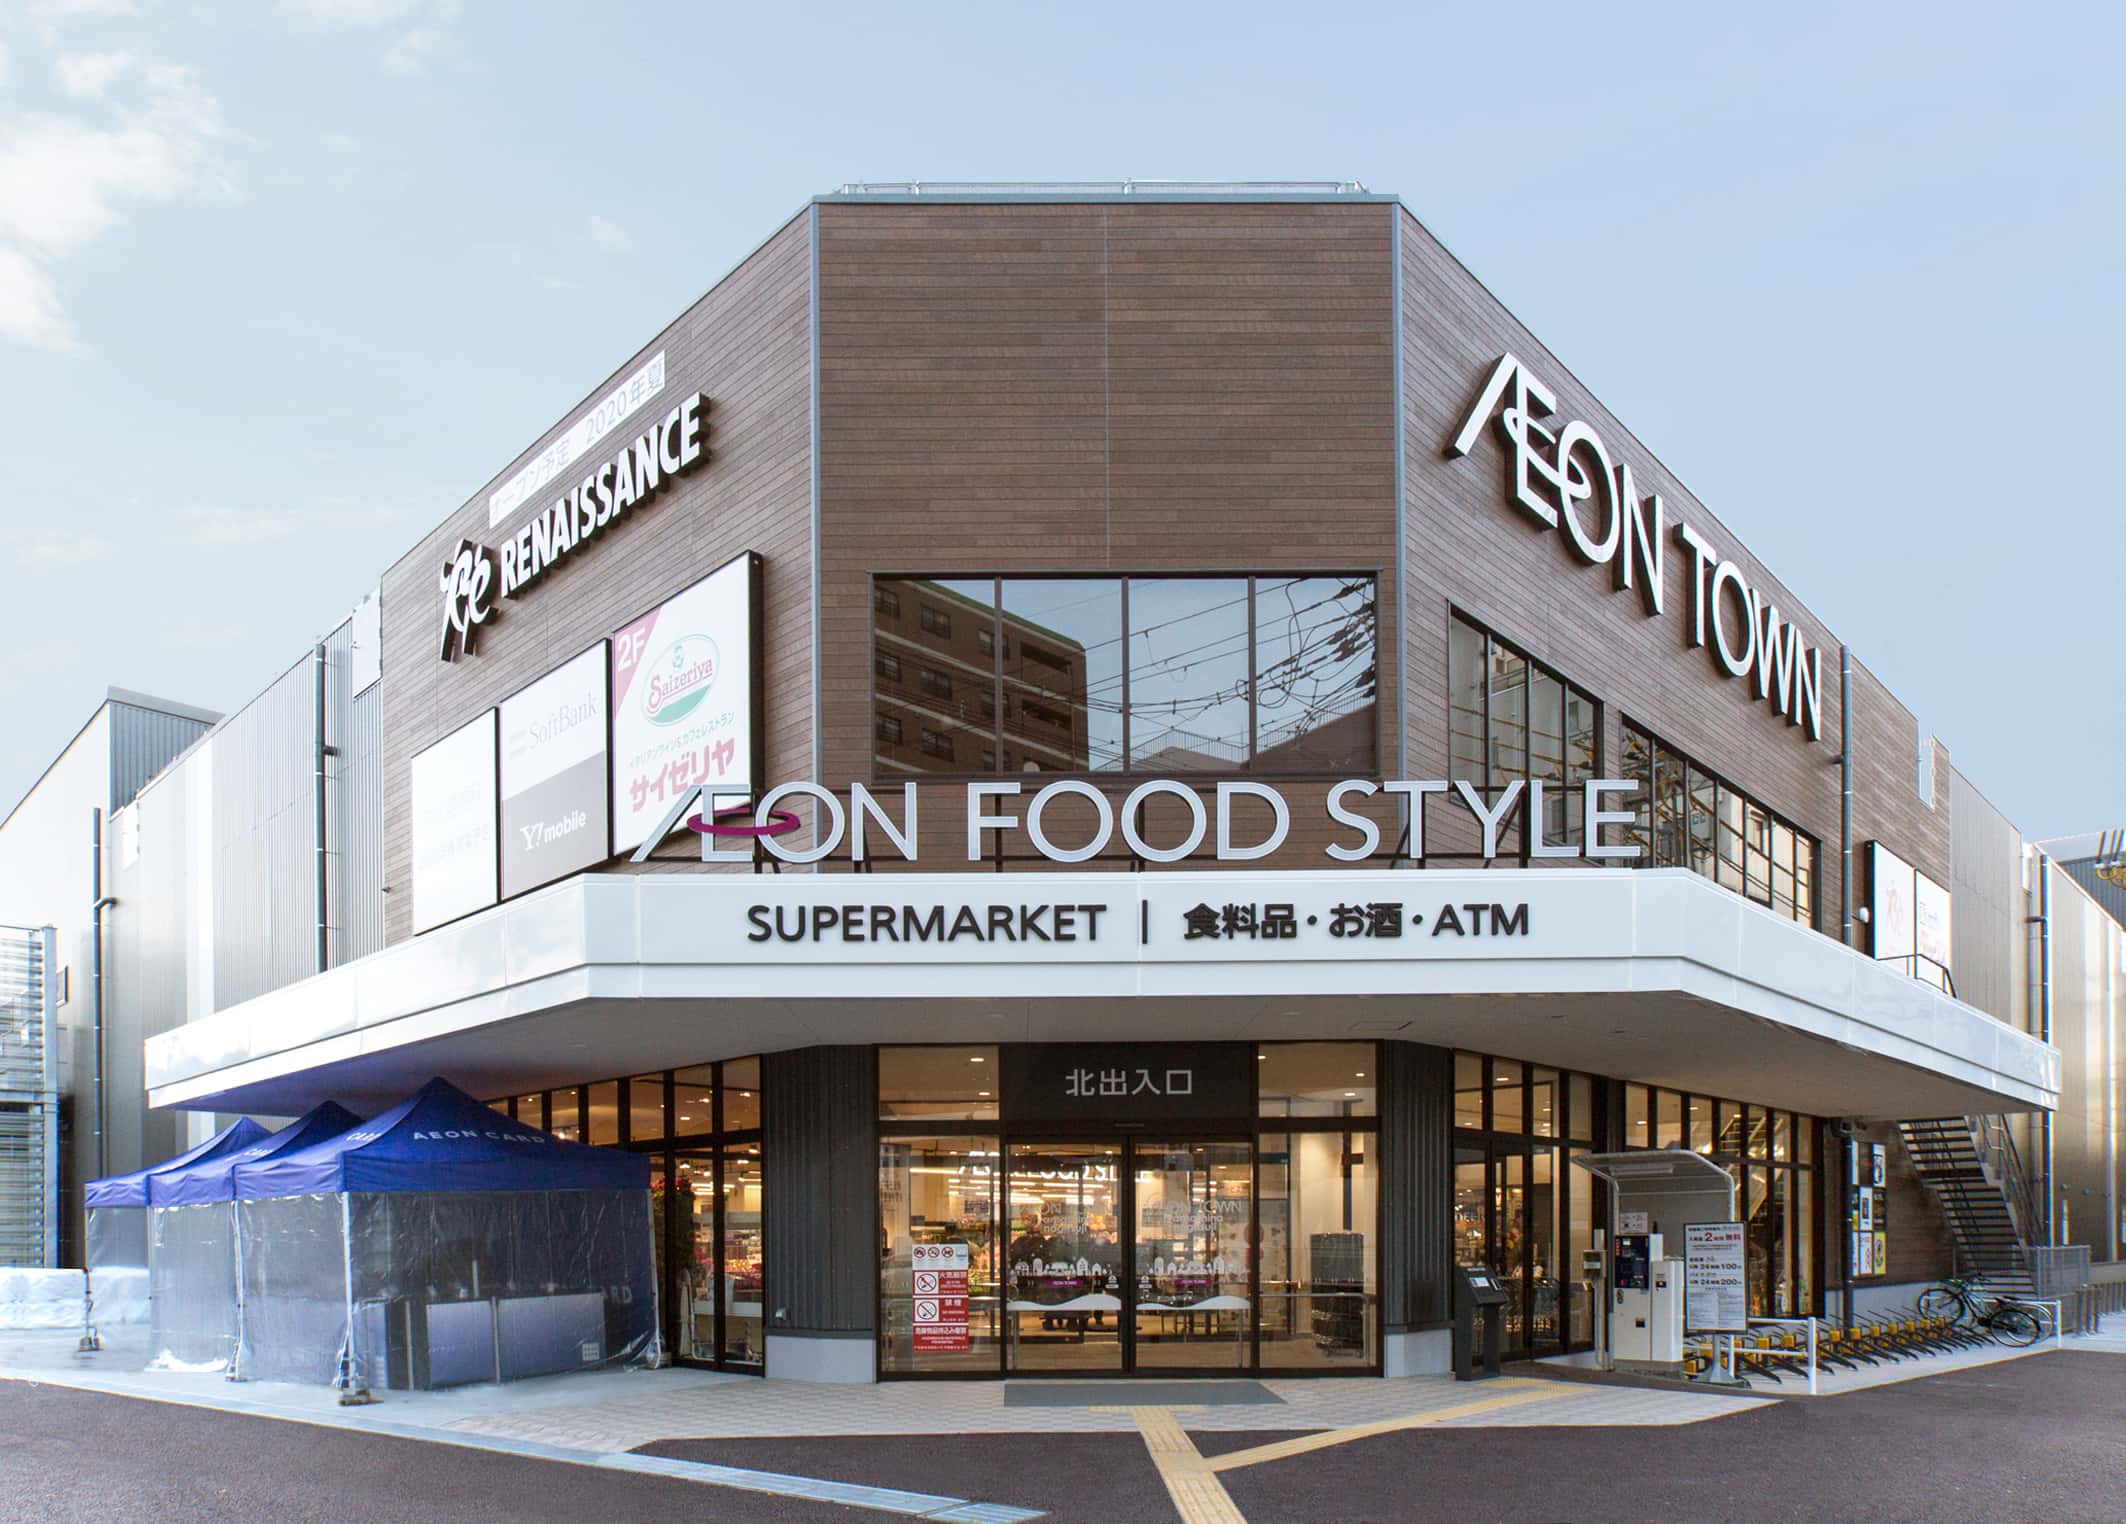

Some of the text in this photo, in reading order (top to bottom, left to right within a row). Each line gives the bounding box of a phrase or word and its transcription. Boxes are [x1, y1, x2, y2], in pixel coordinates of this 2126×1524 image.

[501, 391, 701, 598] RENAISSANCE
[617, 627, 647, 672] 2F
[1680, 522, 1822, 742] TOWN
[647, 656, 714, 714] Saizeriya
[528, 690, 598, 751] SoftBank
[630, 737, 735, 813] サイゼリヤ
[519, 808, 588, 853] Y!mobile
[967, 780, 1291, 865] FOOD
[1324, 778, 1642, 862] STYLE
[746, 904, 1108, 943] SUPERMARKET
[1064, 1067, 1194, 1097] 北出入口
[413, 1128, 545, 1145] AEON CARD
